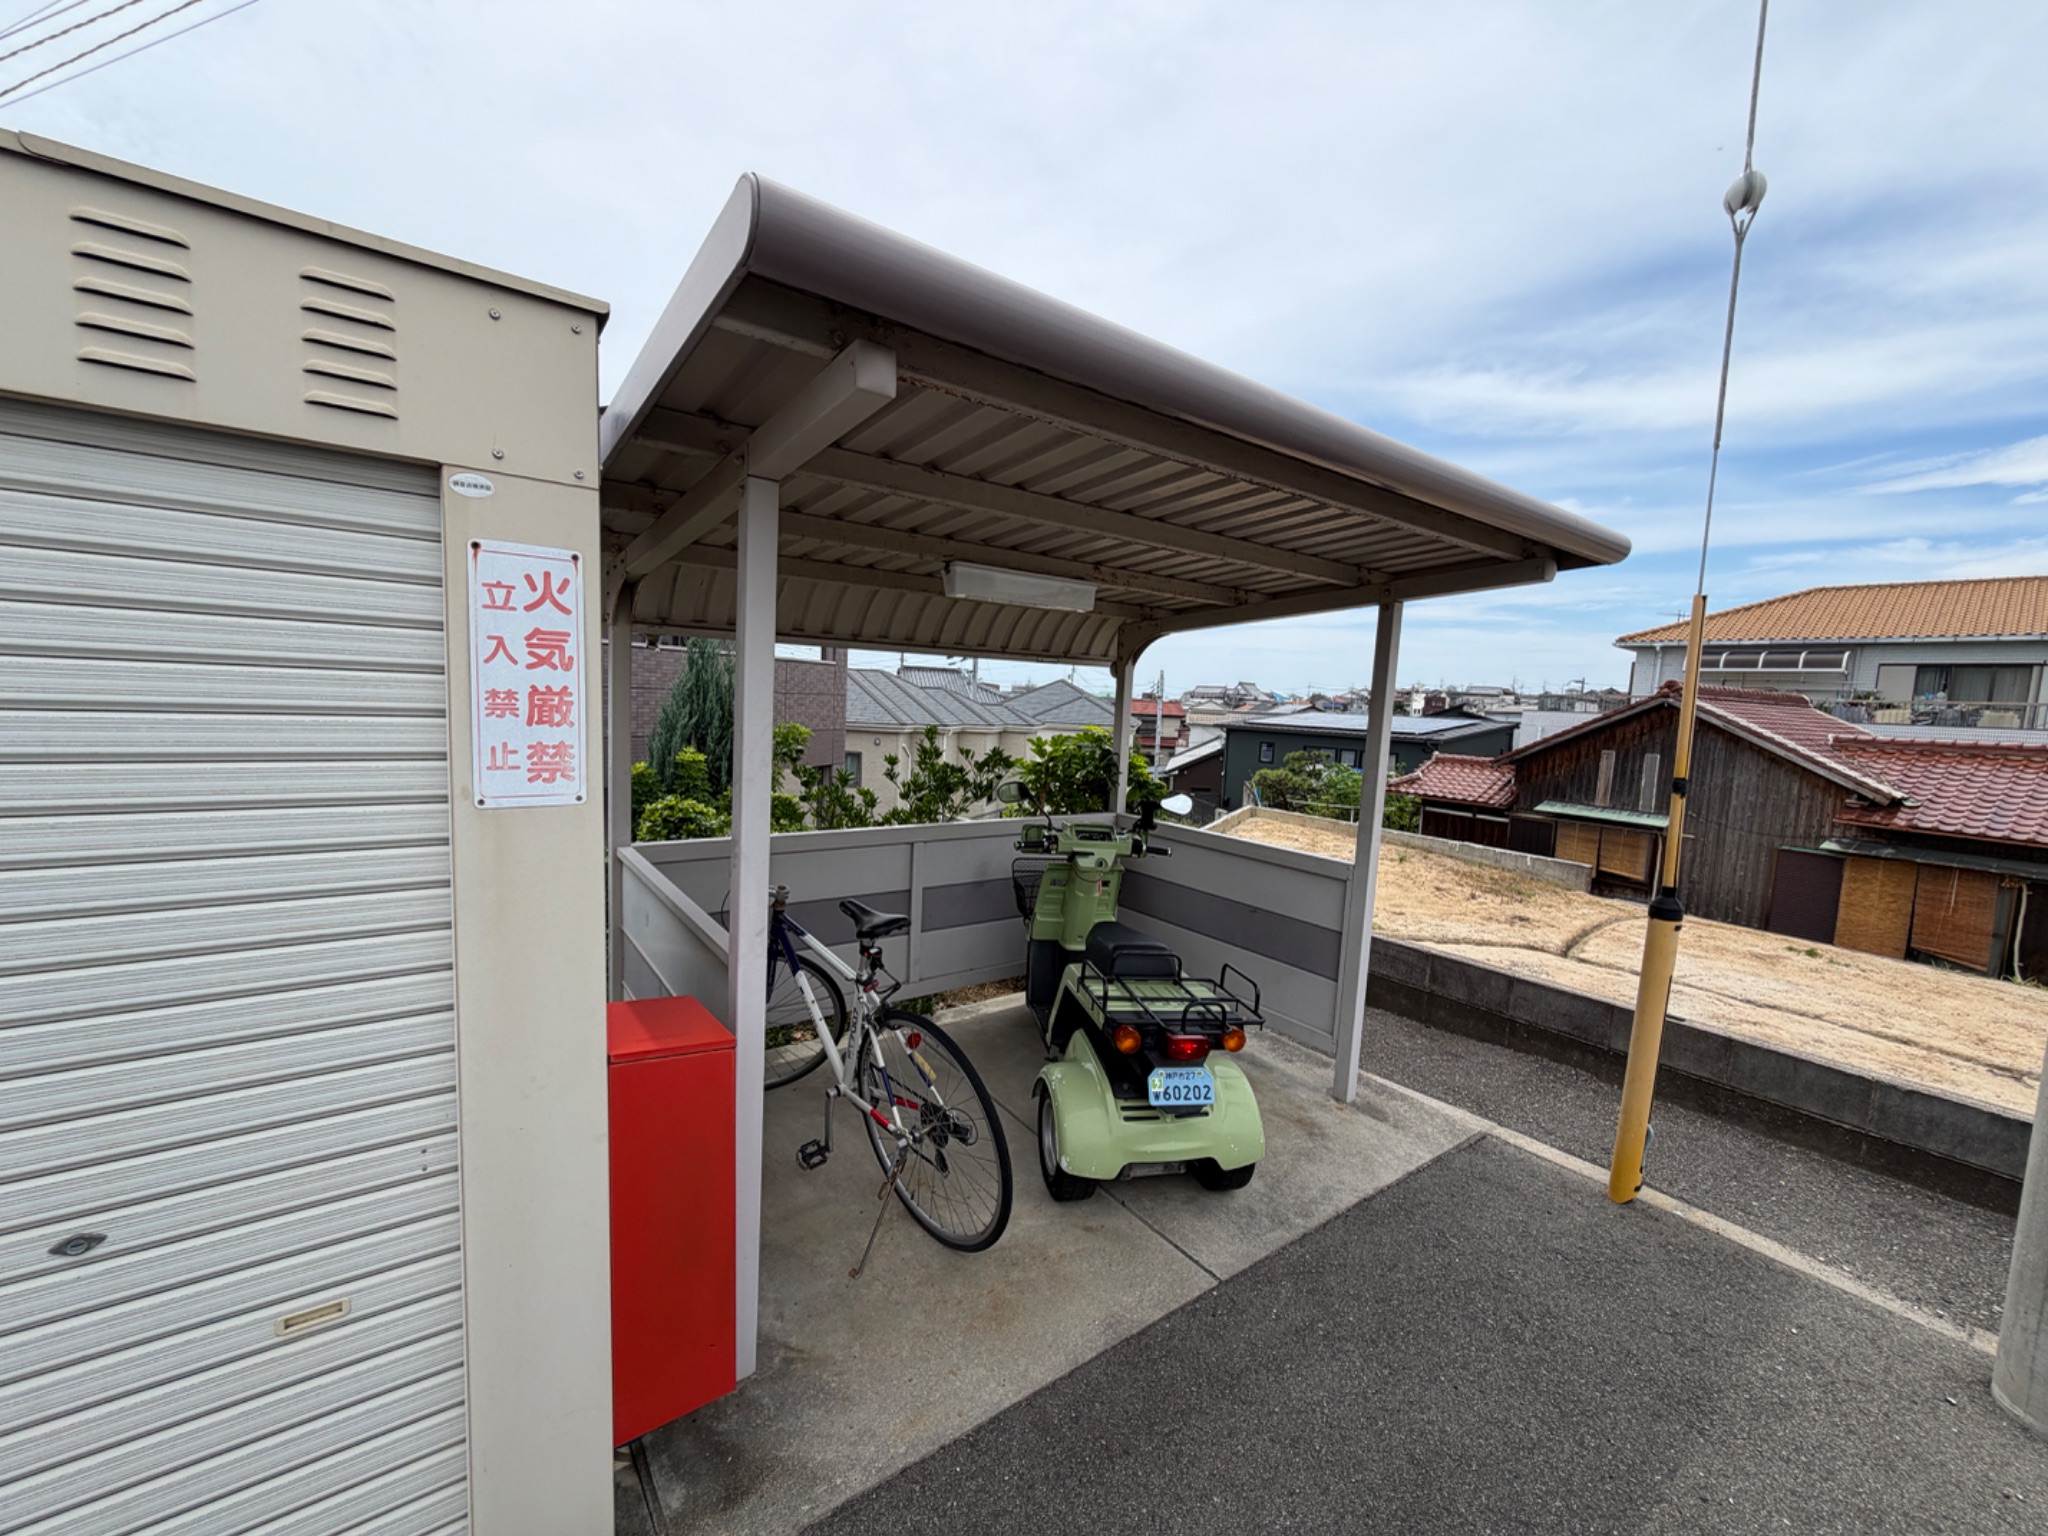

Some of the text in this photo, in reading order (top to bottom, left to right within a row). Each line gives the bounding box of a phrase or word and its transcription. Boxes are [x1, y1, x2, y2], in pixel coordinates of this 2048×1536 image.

[481, 580, 521, 771] 立入禁止
[523, 571, 576, 784] 火気厳禁
